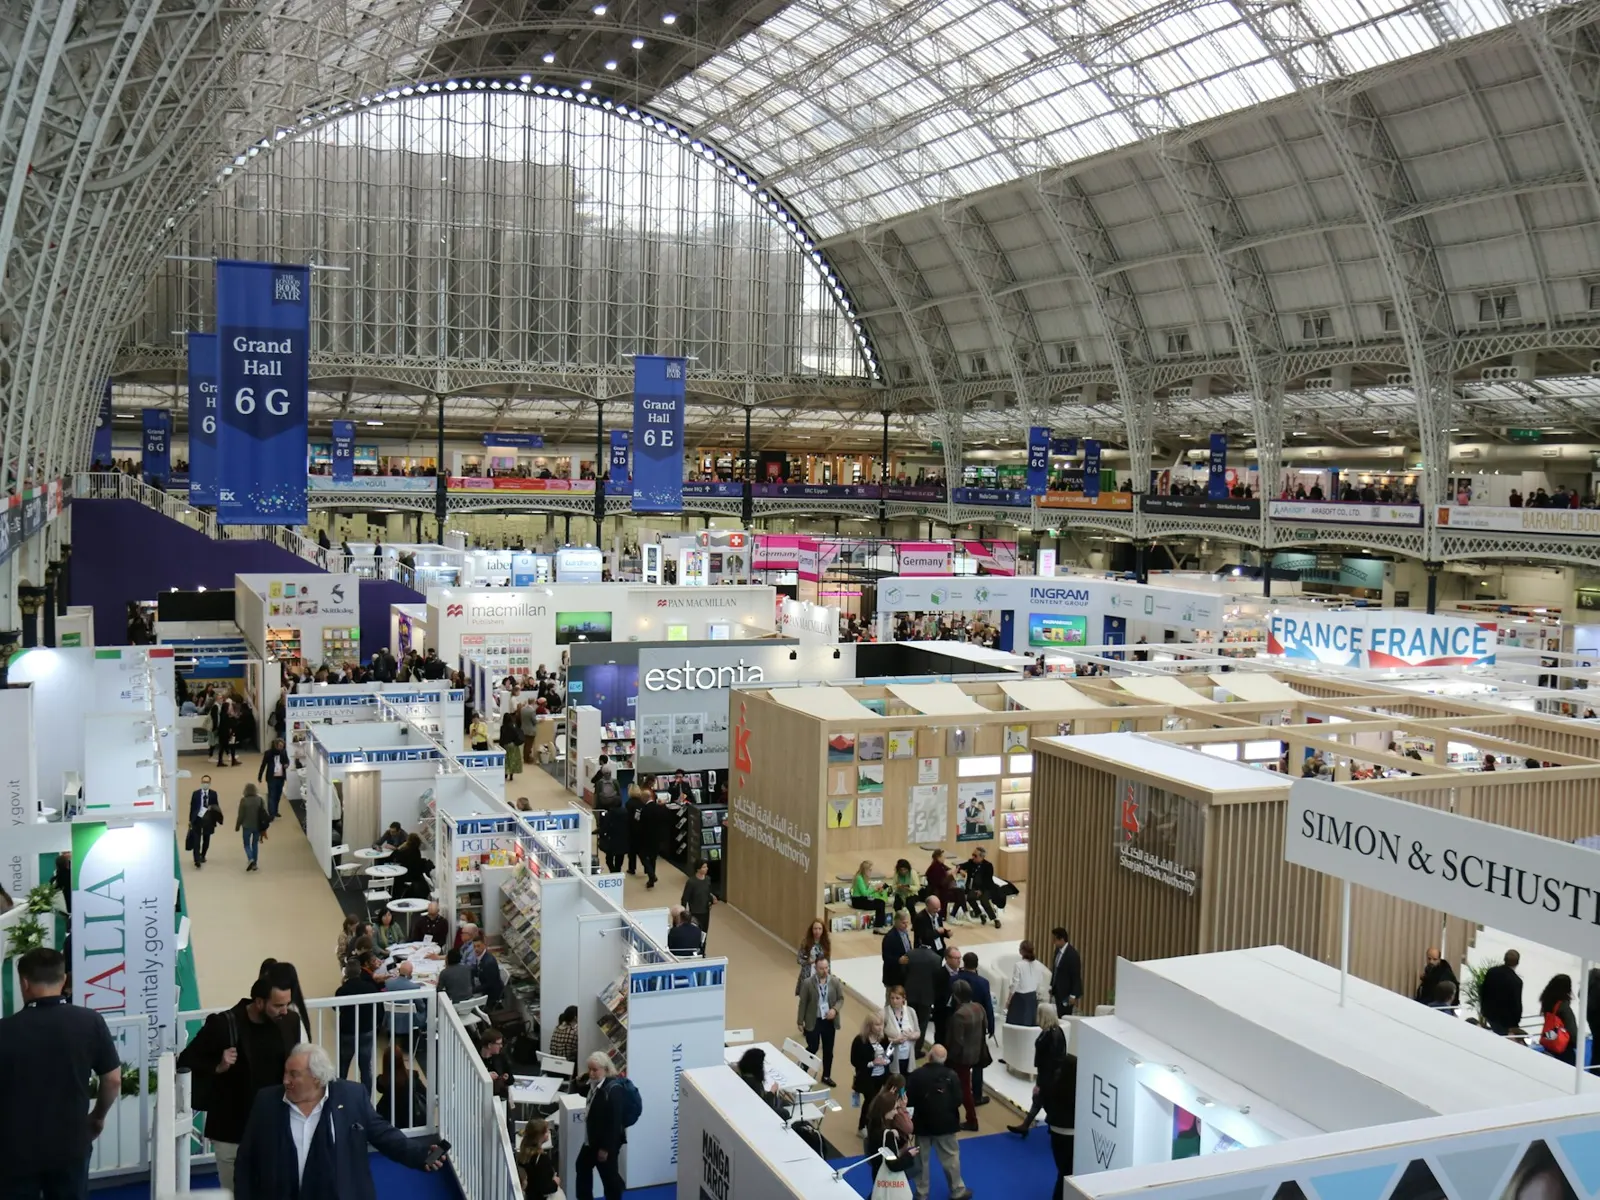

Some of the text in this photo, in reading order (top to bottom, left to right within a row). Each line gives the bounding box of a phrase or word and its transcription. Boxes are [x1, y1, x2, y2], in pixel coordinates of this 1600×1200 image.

[275, 291, 301, 300] FAIR
[233, 336, 292, 355] Grand
[243, 359, 282, 376] Hall
[235, 387, 290, 416] 6 G
[642, 399, 676, 411] Grand
[202, 415, 216, 433] 6
[648, 413, 670, 423] Hall
[643, 429, 674, 447] 6 E
[147, 443, 164, 451] 6 G
[336, 449, 350, 457] 6 E
[1031, 459, 1045, 468] 6 C
[1211, 465, 1217, 473] 6
[759, 550, 797, 559] Germany
[903, 556, 944, 569] Germany
[1030, 587, 1089, 601] INGRAM
[471, 602, 546, 617] macmillan
[668, 598, 737, 608] PAN MACMILLAN
[1271, 616, 1363, 654] FRANCE
[1371, 626, 1488, 657] FRANCE
[645, 658, 764, 692] estonia
[462, 838, 500, 852] PGUK
[733, 812, 811, 873] Sharjah Book Authority
[1301, 808, 1401, 865] SIMON
[1407, 840, 1436, 875] &
[598, 878, 623, 888] 6E30
[1119, 855, 1196, 897] Sharjah Book Authority
[670, 1043, 684, 1165] Publishers Group UK
[702, 1128, 730, 1183] MANGA
[703, 1155, 730, 1200] TAROT
[876, 1180, 906, 1189] BOOKBAR
